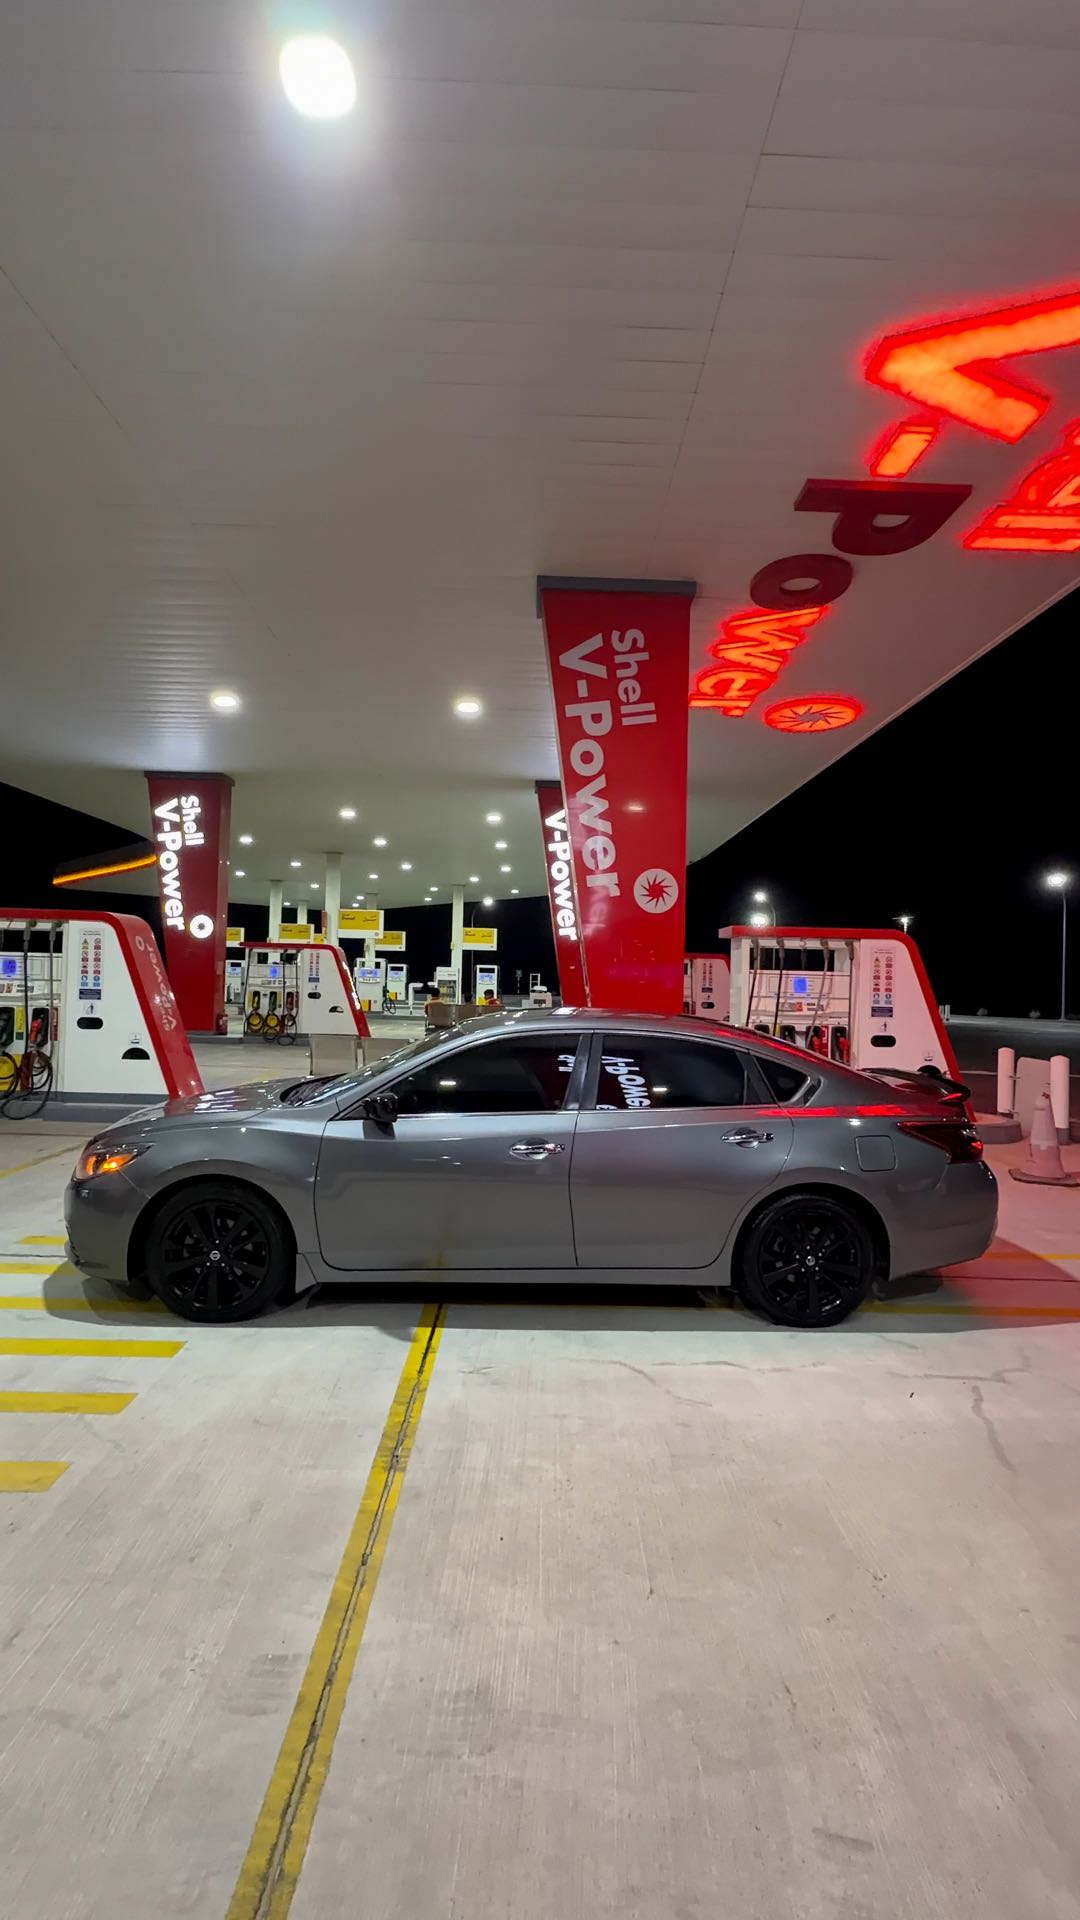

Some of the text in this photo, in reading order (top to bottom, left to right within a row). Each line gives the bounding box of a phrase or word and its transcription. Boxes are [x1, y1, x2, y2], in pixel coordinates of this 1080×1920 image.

[684, 290, 1080, 718] V-Power
[611, 628, 657, 726] Shell
[180, 795, 205, 846] Shell
[559, 632, 622, 898] V-Power
[154, 797, 186, 931] V-Power
[545, 808, 578, 941] V-Power
